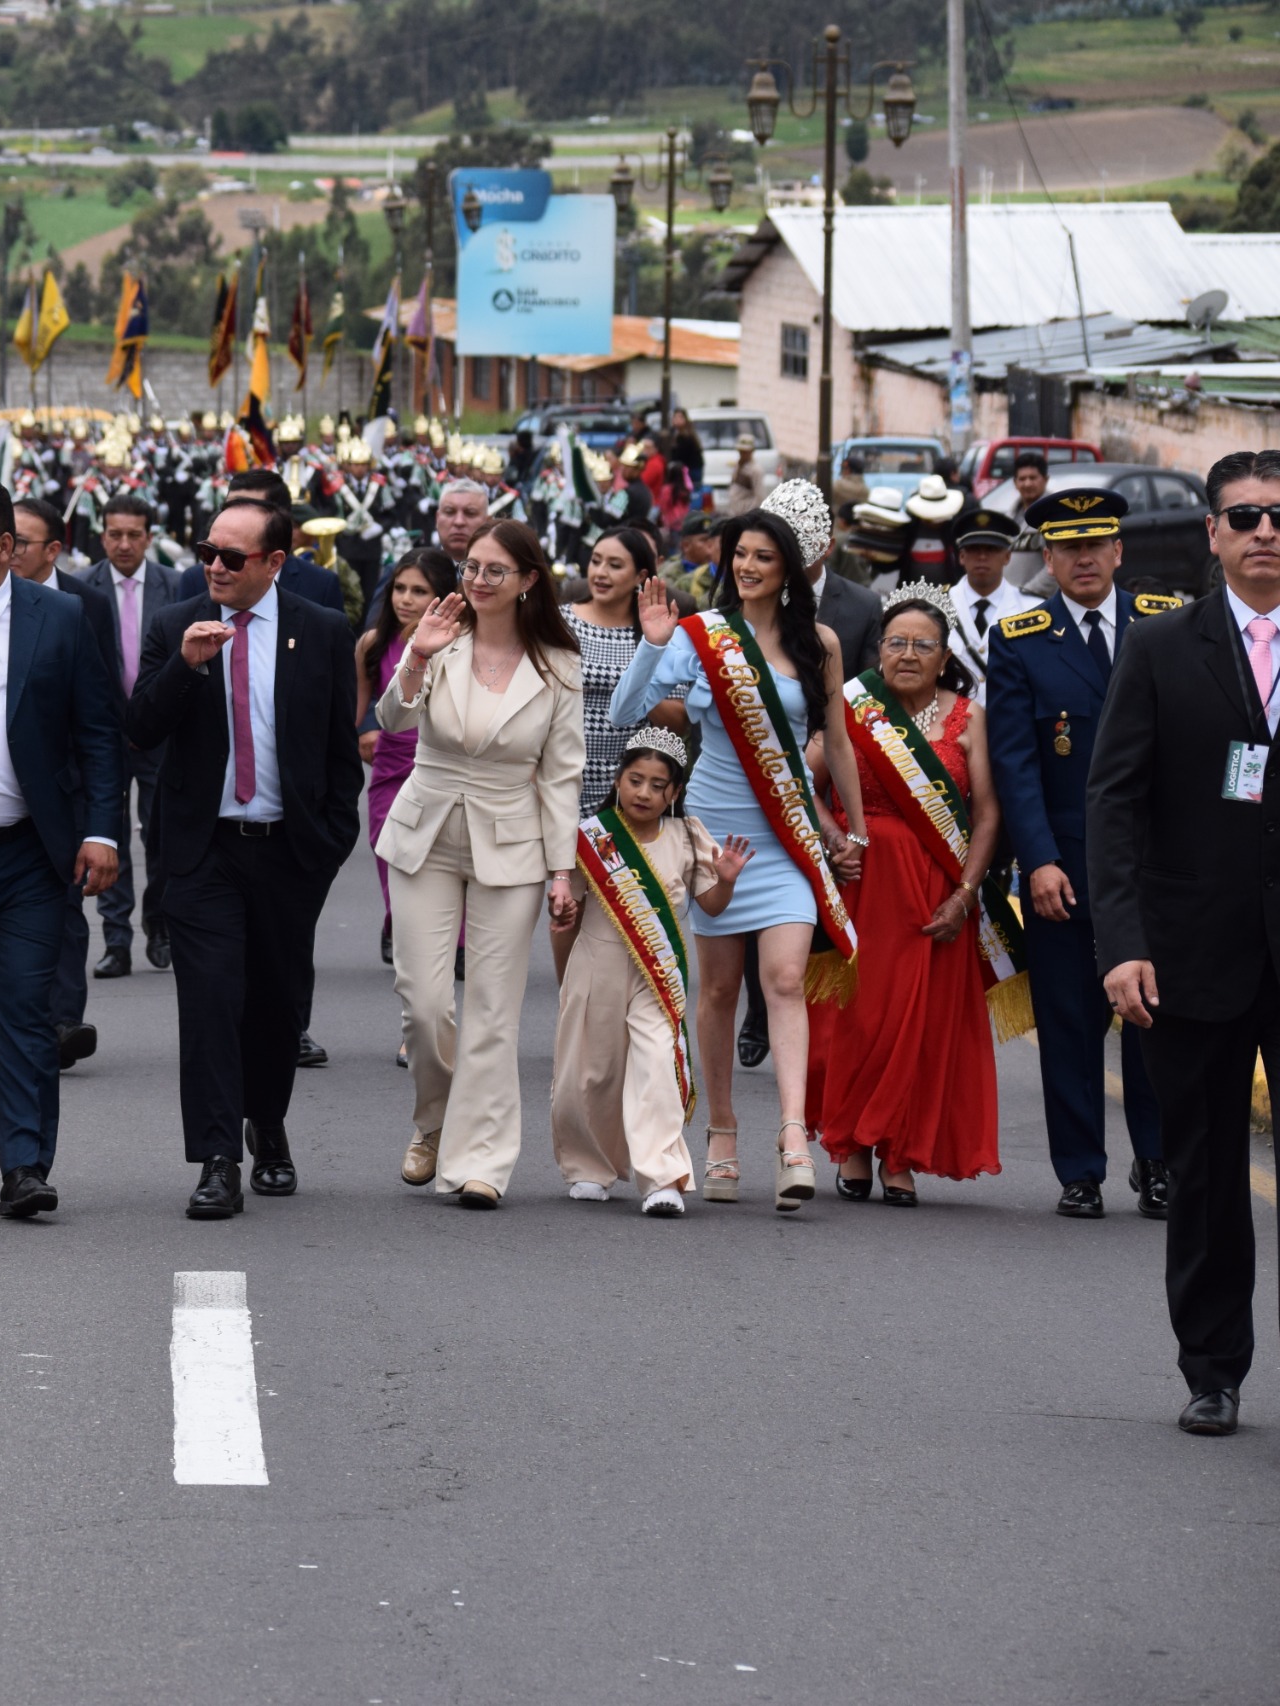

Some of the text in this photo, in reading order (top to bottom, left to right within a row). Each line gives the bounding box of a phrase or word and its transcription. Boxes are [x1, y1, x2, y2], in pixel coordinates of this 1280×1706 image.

[718, 664, 821, 868] Reina de Mocha
[873, 726, 958, 840] Reina Adulto
[1227, 748, 1241, 792] LOGÍSTICA
[605, 868, 666, 956] Mochana
